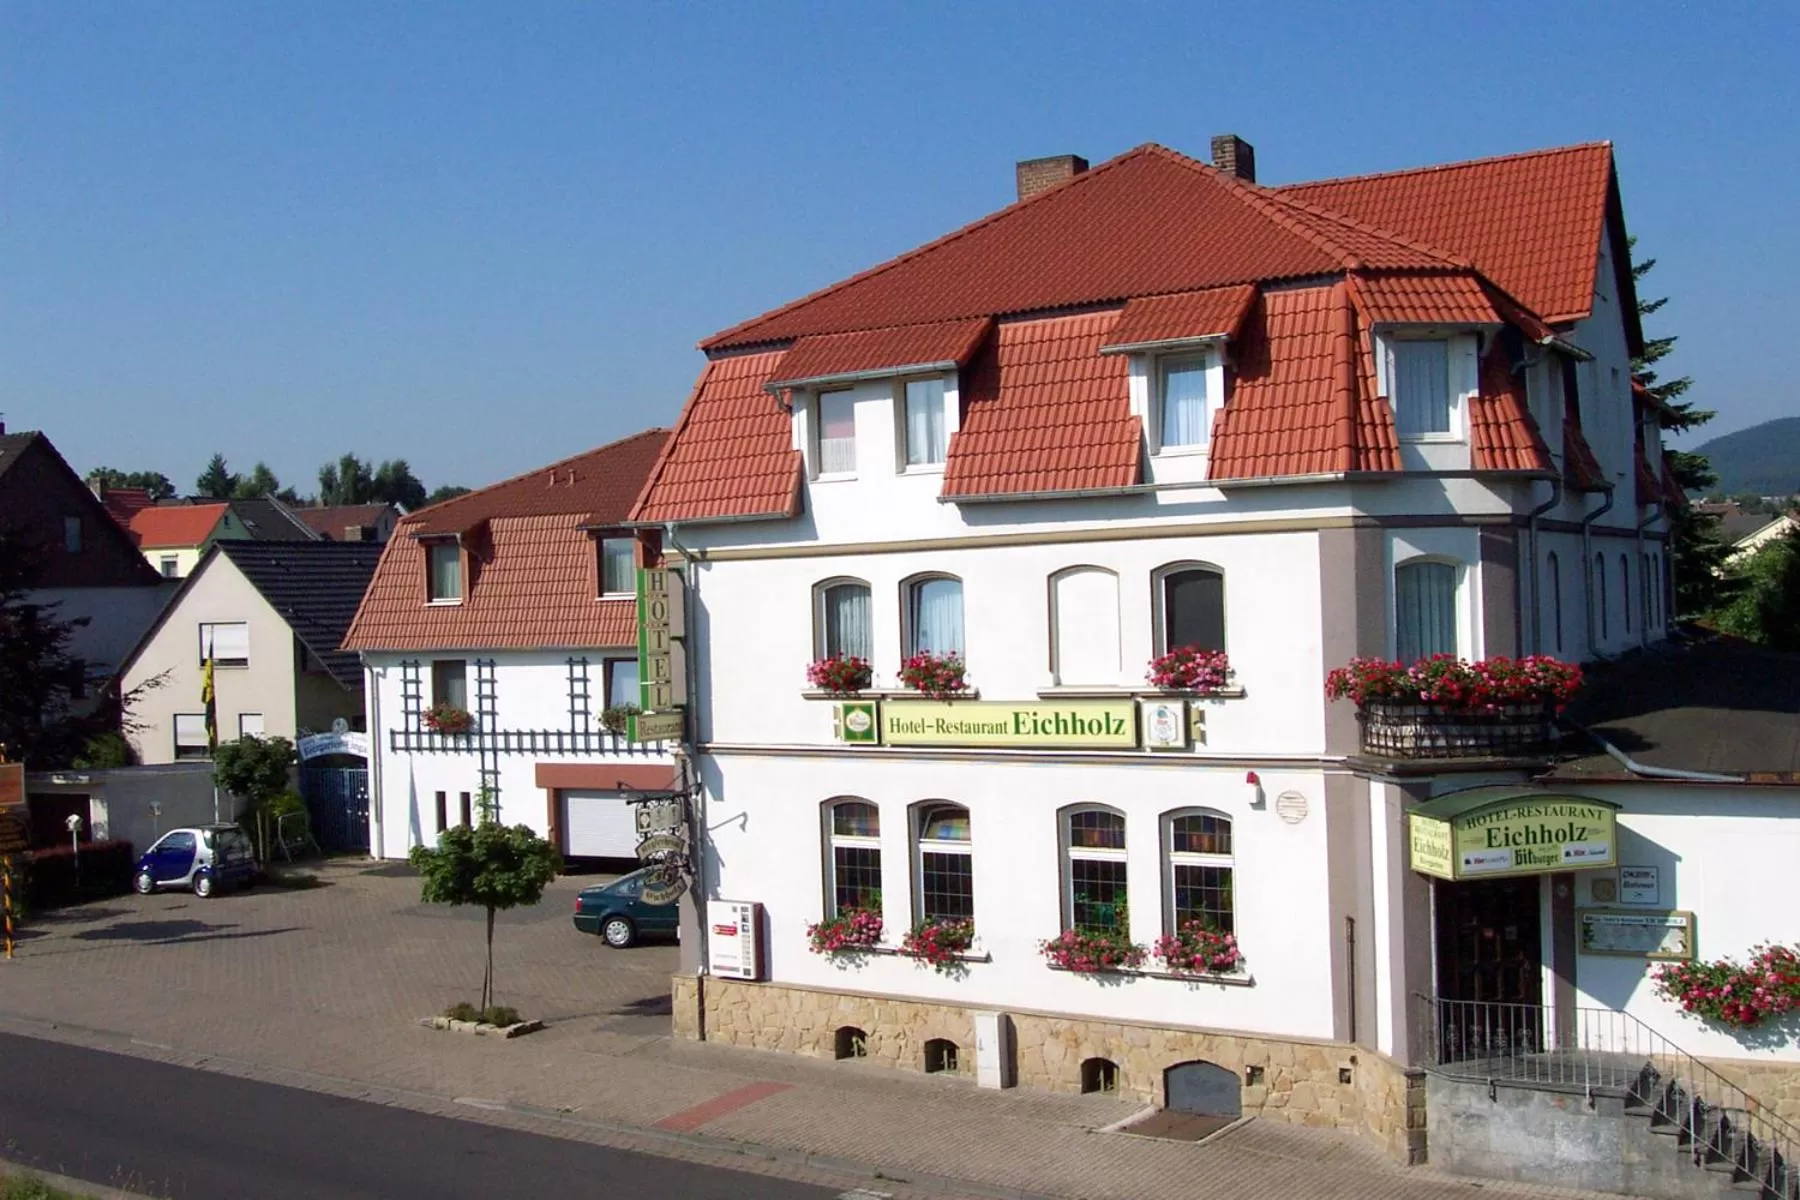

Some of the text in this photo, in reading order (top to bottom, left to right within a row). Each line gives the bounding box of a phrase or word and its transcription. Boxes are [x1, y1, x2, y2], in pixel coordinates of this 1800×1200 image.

[651, 572, 668, 706] HOTEL
[889, 717, 1008, 735] Hotel-Restaurant
[1012, 711, 1126, 736] Eichholz
[1465, 805, 1605, 830] HOTEL-RESTAURANT
[1414, 835, 1450, 861] Eichholz
[1485, 822, 1588, 849] Eichholz
